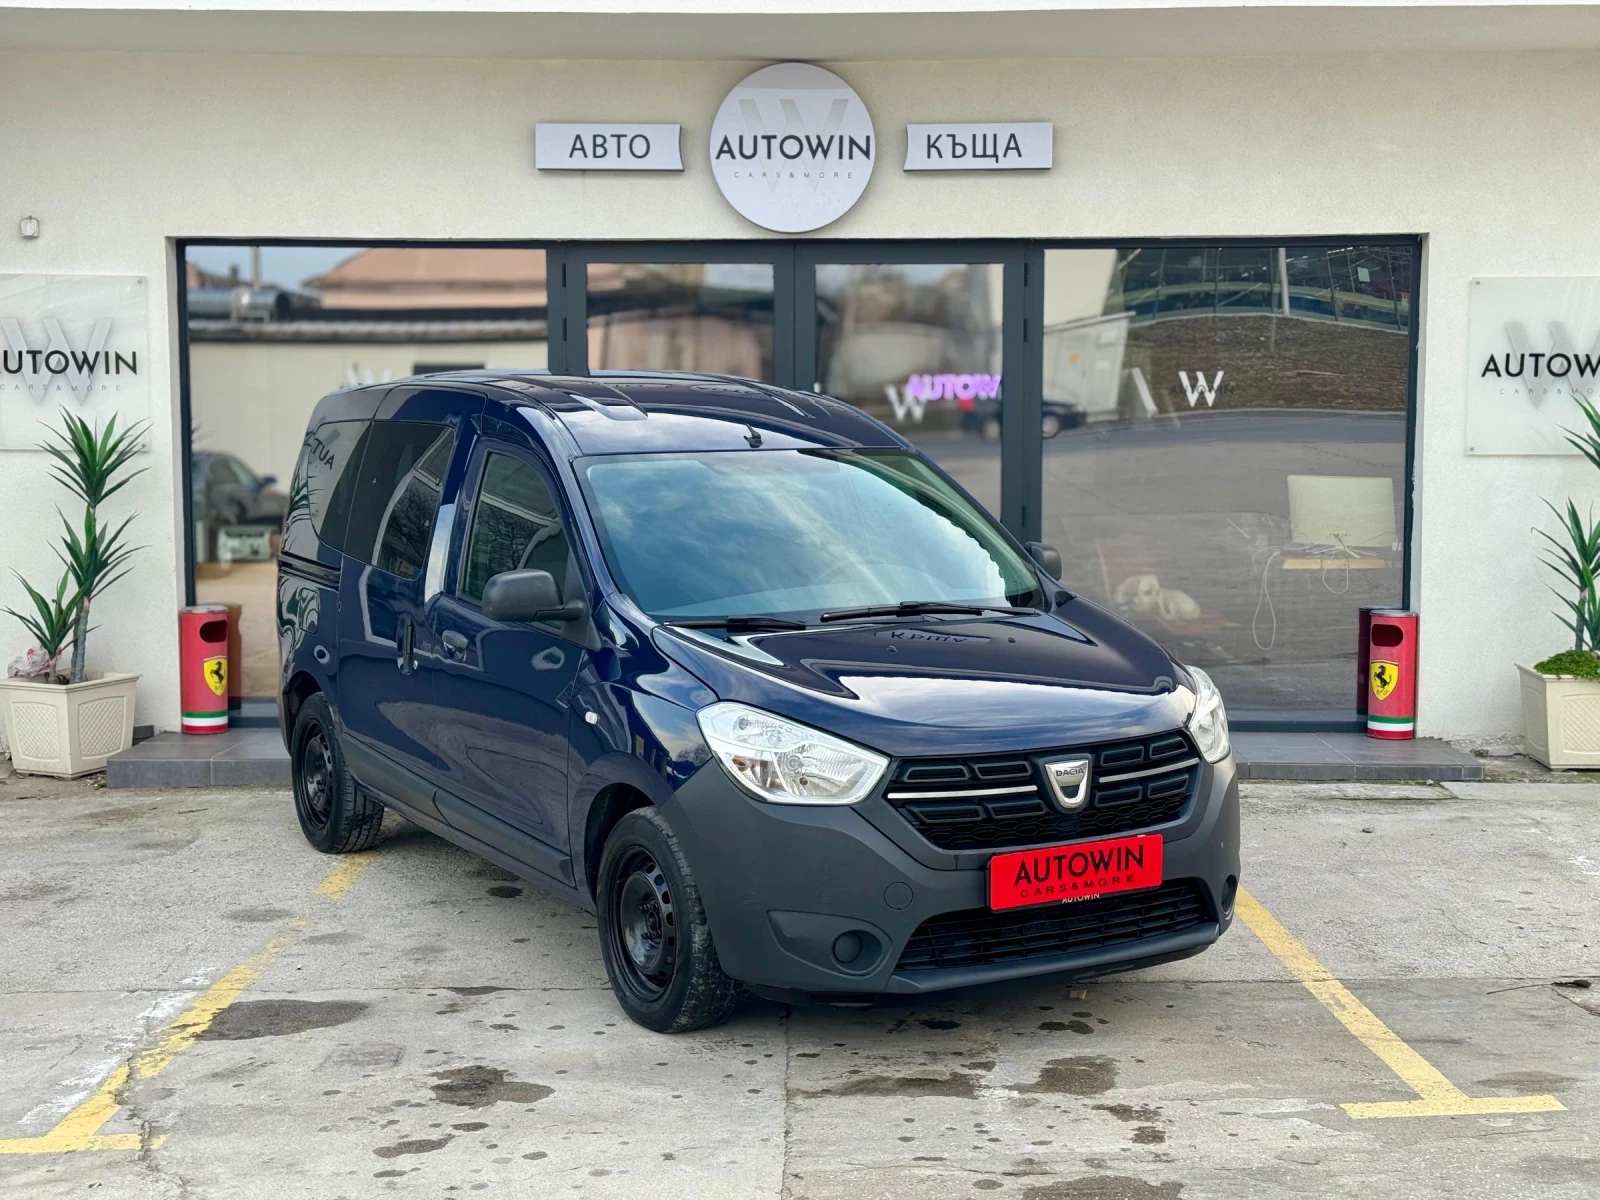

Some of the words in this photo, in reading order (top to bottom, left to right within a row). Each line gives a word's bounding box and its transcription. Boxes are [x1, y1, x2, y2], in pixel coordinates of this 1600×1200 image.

[568, 133, 651, 159] АВТО
[715, 134, 871, 160] AUTOWIN
[926, 132, 1023, 164] КЪЩА
[733, 171, 853, 179] CARS&MORE
[0, 349, 138, 376] UTOWIN
[1055, 767, 1085, 777] DACIA
[1014, 844, 1144, 887] AUTOWIN
[1020, 873, 1136, 898] CARS&MORE
